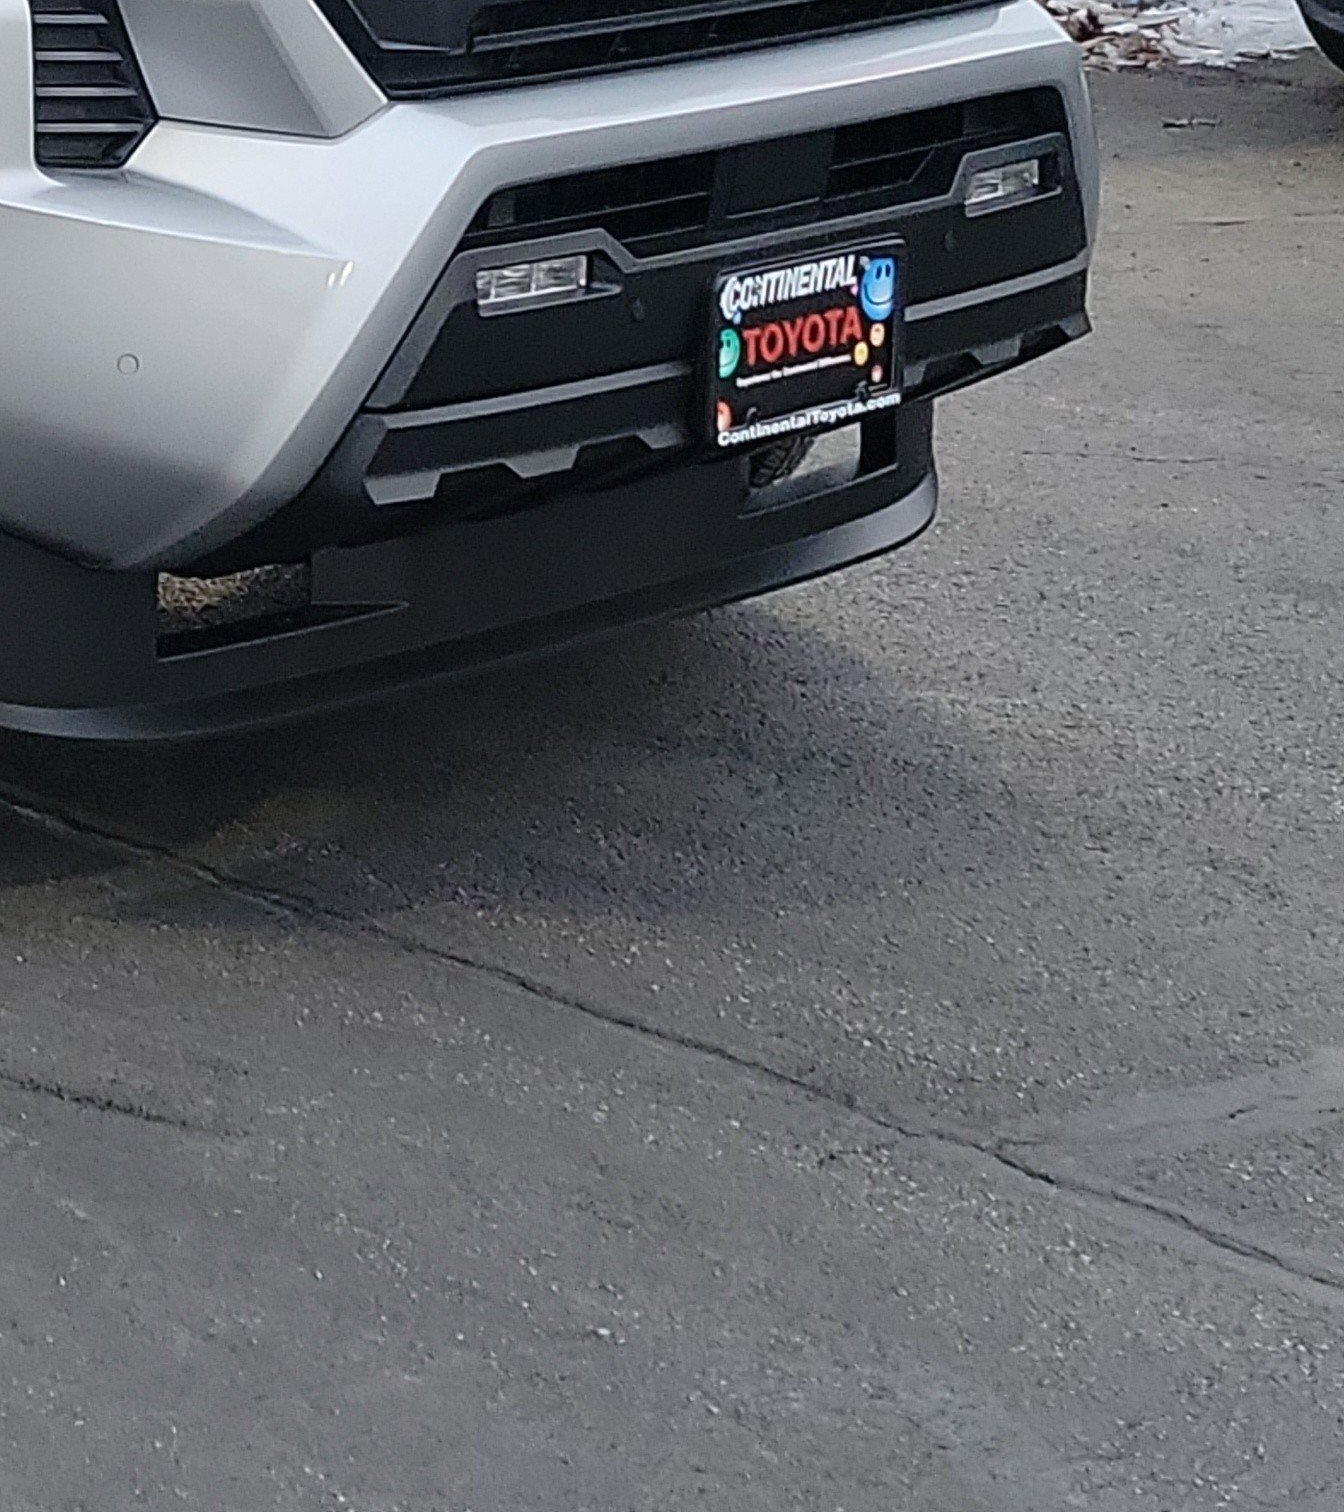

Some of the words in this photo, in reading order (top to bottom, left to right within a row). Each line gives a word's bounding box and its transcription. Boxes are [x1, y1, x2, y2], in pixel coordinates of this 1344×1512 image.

[719, 254, 858, 321] CONTINENTAL
[742, 306, 863, 367] TOYOTA
[717, 392, 902, 448] ContinentalToyota.com
